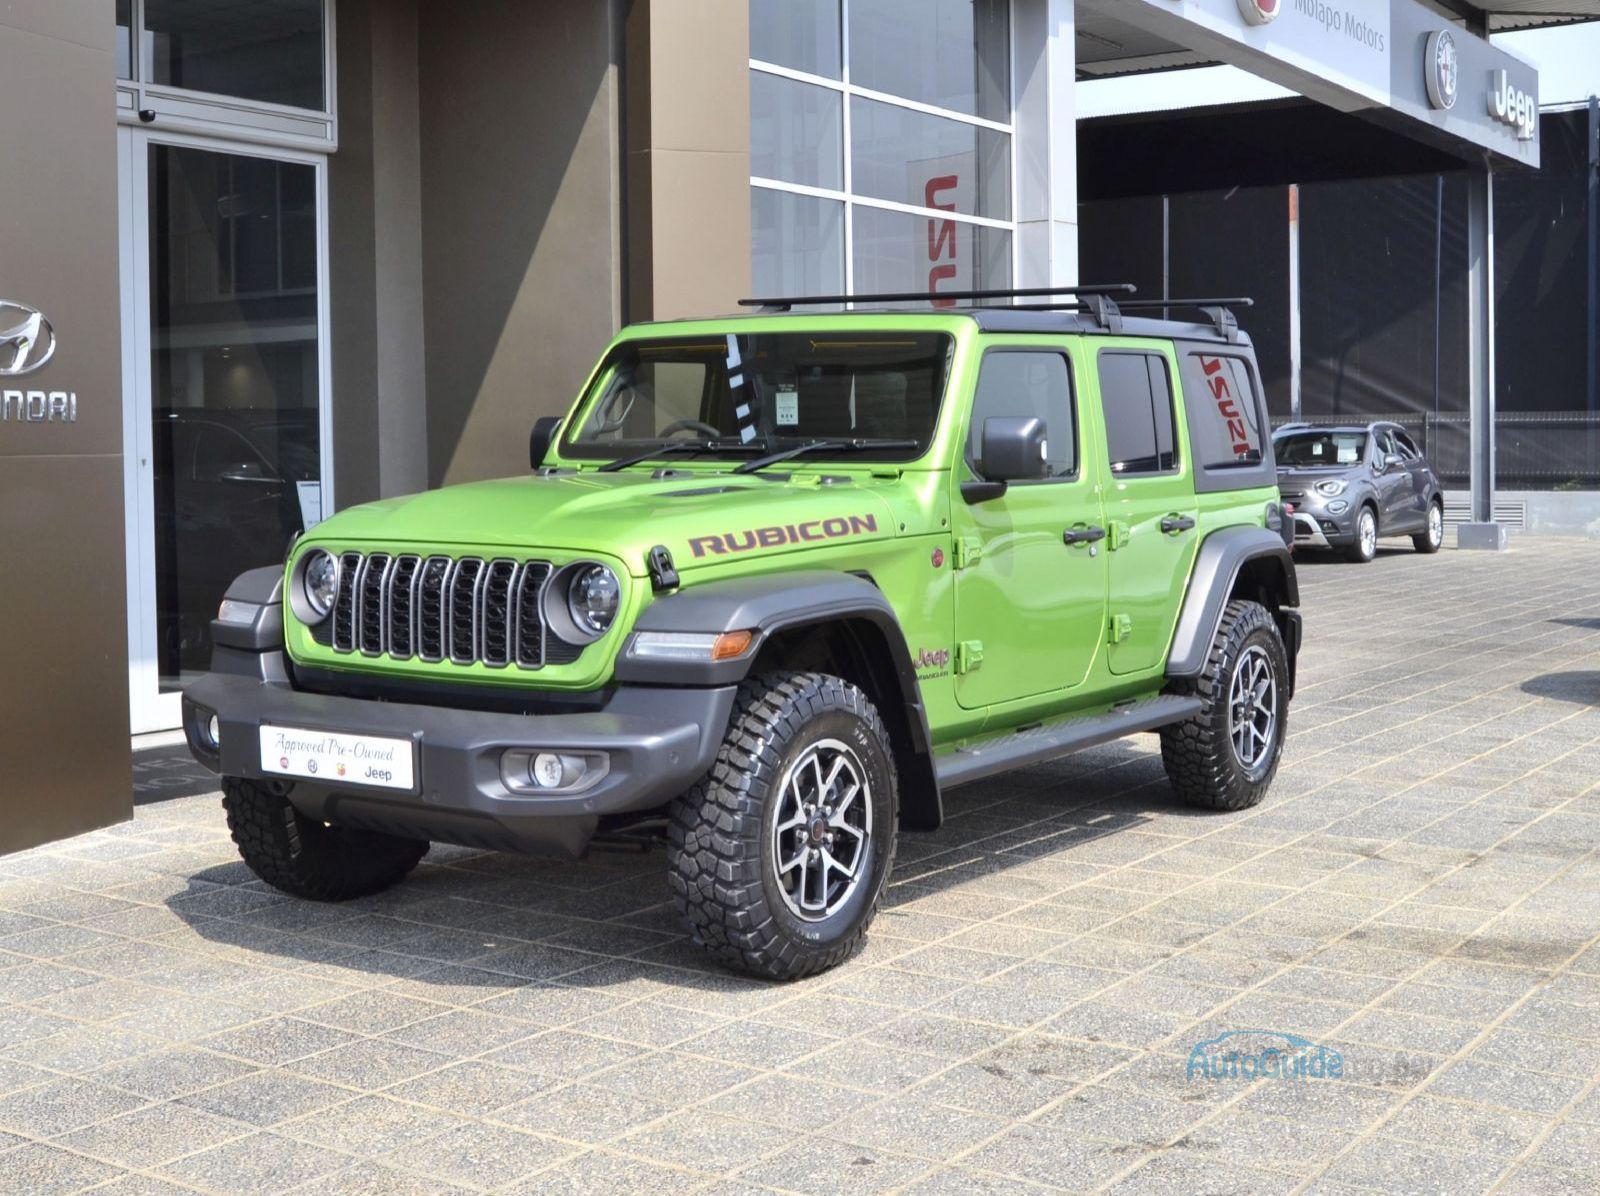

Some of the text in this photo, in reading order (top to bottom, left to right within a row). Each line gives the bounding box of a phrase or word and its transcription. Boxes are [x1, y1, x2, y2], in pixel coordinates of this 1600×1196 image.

[1344, 12, 1385, 52] Motors
[1494, 69, 1535, 138] Jeep
[0, 390, 77, 421] NDAI
[688, 514, 878, 558] RUBICON
[912, 647, 949, 669] Jeep
[275, 732, 394, 761] Approved Pre-Owned
[365, 766, 392, 782] Jeep
